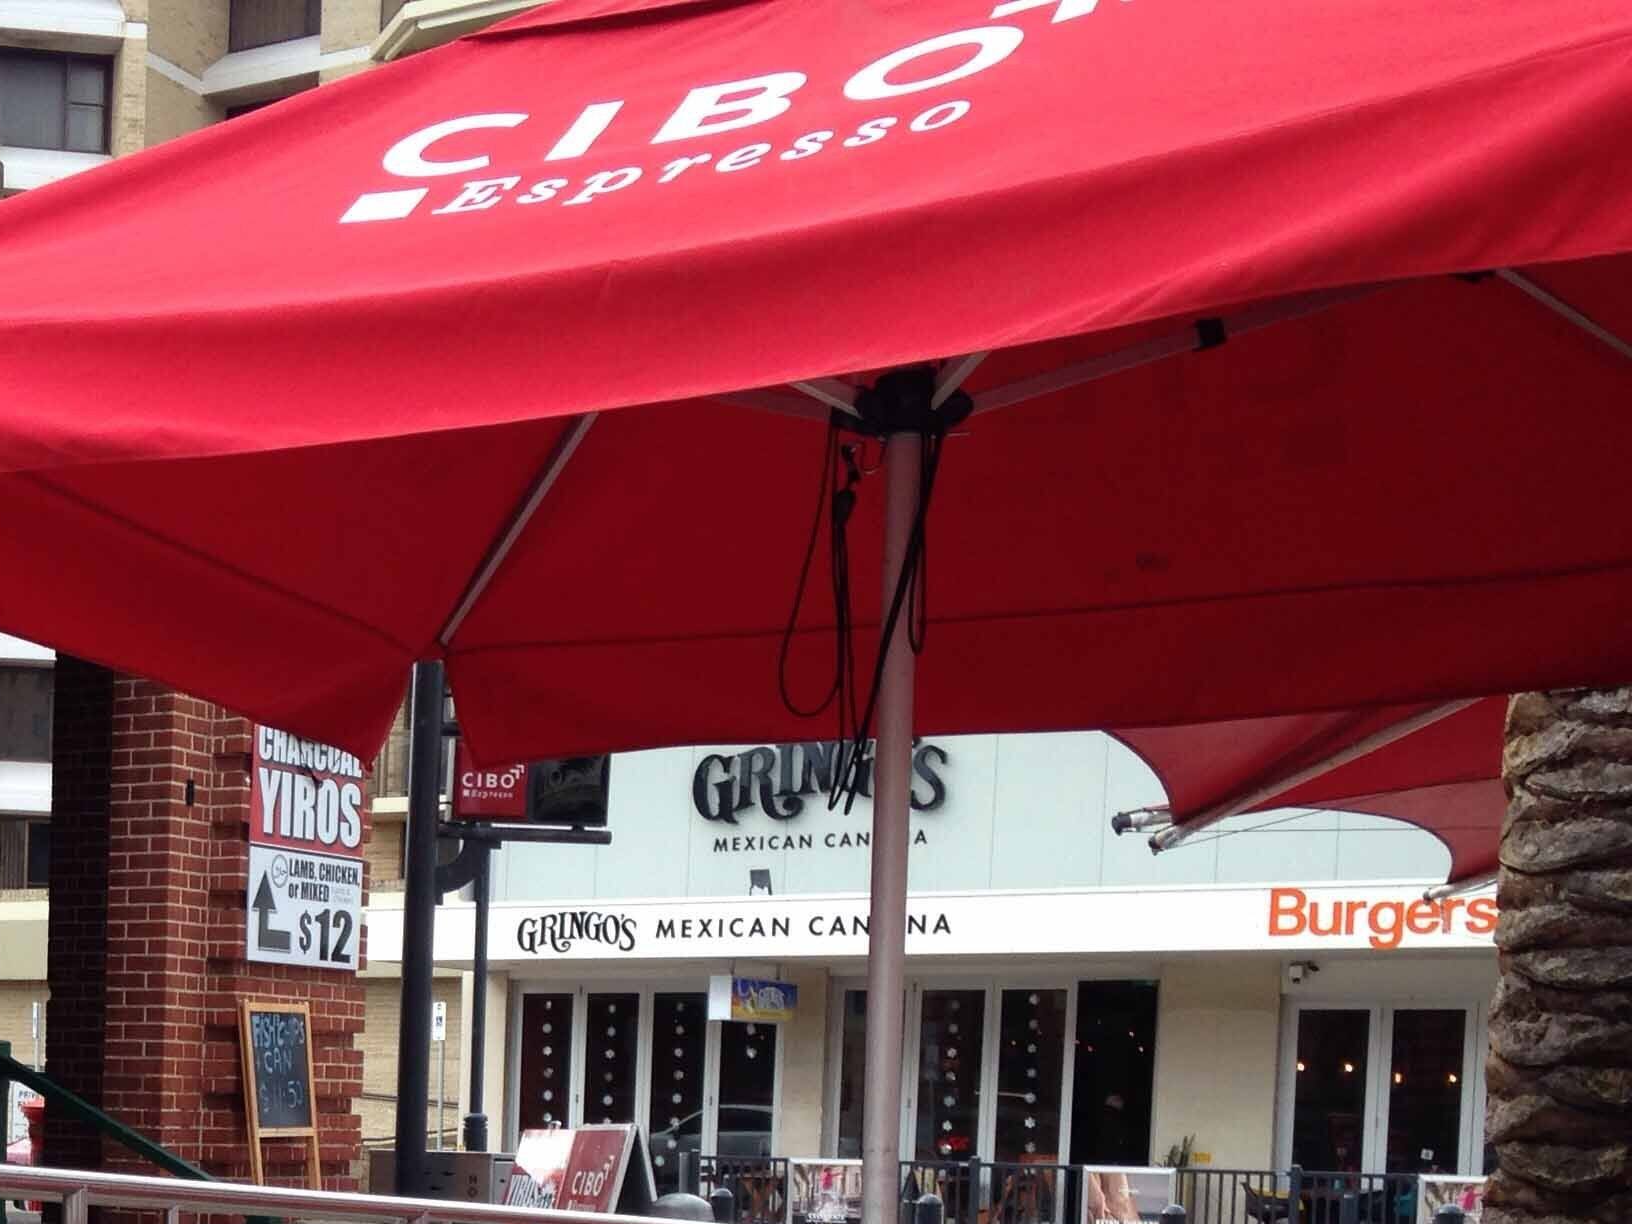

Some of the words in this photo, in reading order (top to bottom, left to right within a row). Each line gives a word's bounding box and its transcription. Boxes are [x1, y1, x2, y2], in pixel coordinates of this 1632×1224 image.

[382, 25, 1025, 178] CIBO
[432, 99, 972, 216] Espresso
[462, 773, 515, 789] CIBO
[258, 767, 362, 849] YIROS
[713, 834, 813, 853] MEXICAN
[824, 830, 928, 848] CANA
[288, 883, 300, 899] or
[301, 882, 330, 903] MIXED
[289, 858, 317, 882] LAMB,
[319, 862, 360, 888] CHICKEN,
[299, 908, 353, 964] $12
[517, 911, 637, 953] GRINGO'S
[655, 917, 791, 939] MEXICAN
[808, 914, 952, 938] CANNA
[1268, 887, 1500, 950] Burgers
[572, 1169, 605, 1196] CIBO
